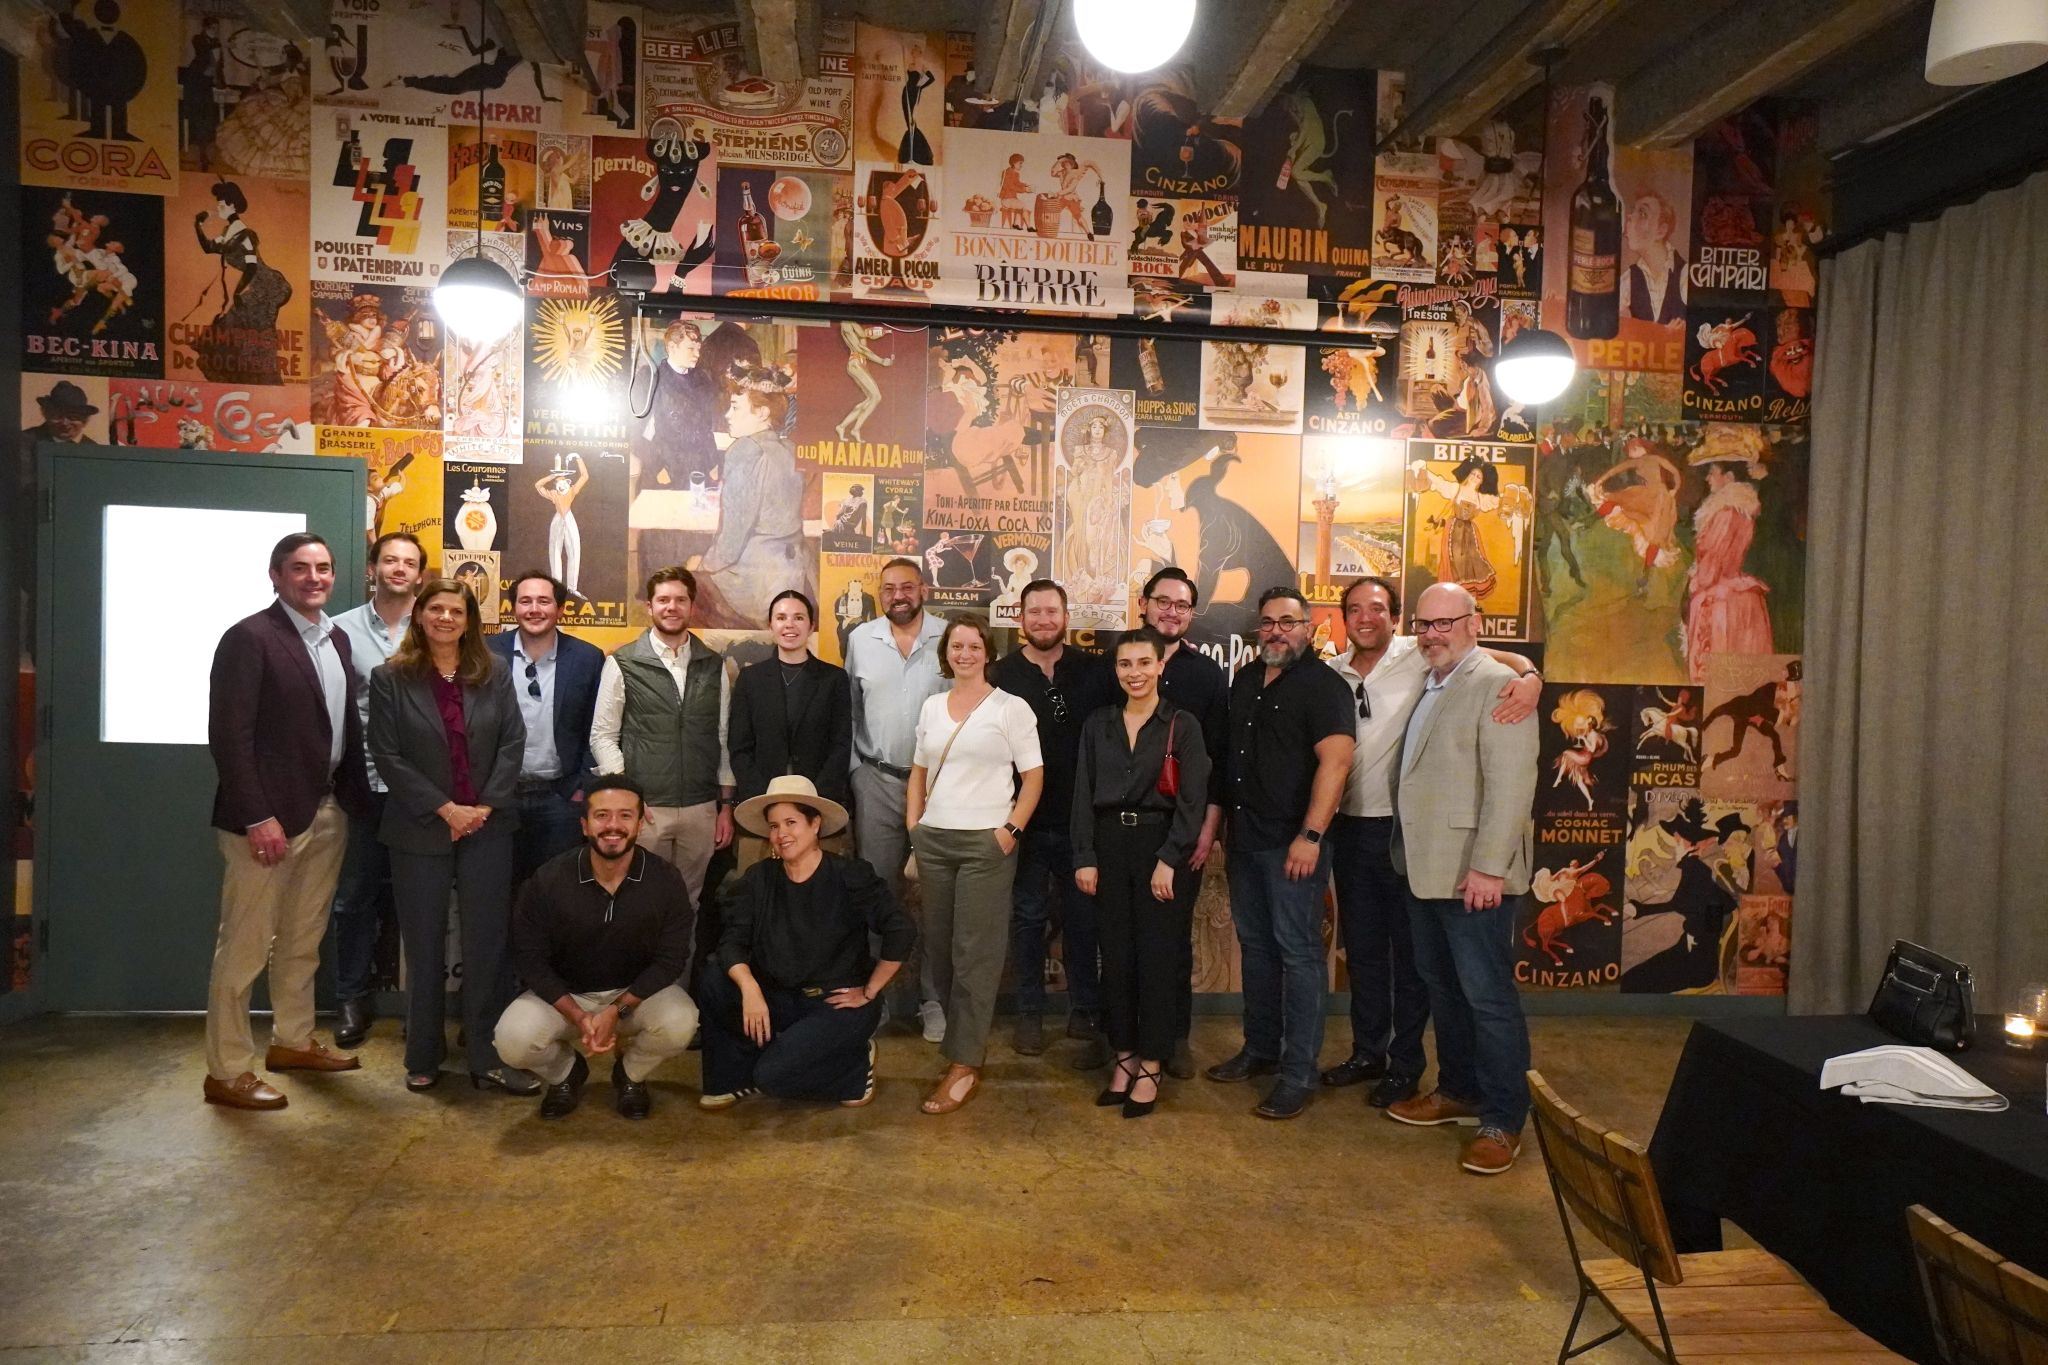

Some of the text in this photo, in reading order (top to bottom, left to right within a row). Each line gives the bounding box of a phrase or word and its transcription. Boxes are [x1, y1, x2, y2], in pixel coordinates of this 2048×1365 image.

[645, 43, 693, 59] BEEF
[808, 87, 843, 97] OLD PORT
[810, 100, 831, 108] WINE
[360, 113, 368, 121] A
[370, 114, 400, 124] VOTRE
[451, 100, 542, 124] CAMPARI
[26, 138, 171, 179] CORA
[1145, 167, 1227, 194] CINZANO
[552, 219, 584, 231] VINS
[314, 240, 374, 256] POUSSET
[1239, 224, 1369, 267] MAURIN QUINA
[1701, 247, 1760, 267] BITTER
[333, 256, 424, 277] SPATENBRÄU
[855, 257, 890, 276] AMER
[1132, 262, 1174, 275] BOCK
[1245, 261, 1285, 272] LE PUY
[1335, 270, 1362, 278] FRANCE
[1689, 263, 1767, 290] CAMPARI
[527, 278, 589, 296] CAMP ROMAIN
[860, 276, 934, 289] CHAUD
[311, 290, 353, 301] CAMPARI
[27, 335, 159, 360] BEC-KINA
[1588, 340, 1683, 369] PERLE
[1683, 390, 1762, 412] CINZANO
[1336, 412, 1360, 421] ASTI
[527, 421, 627, 438] MARTINI
[1308, 415, 1386, 434] CINZANO
[322, 428, 372, 438] GRANDE
[320, 439, 376, 450] BRASSERIE
[524, 438, 558, 446] MARTINI
[797, 441, 924, 468] OLD MANADA RUM
[446, 462, 507, 474] Les Couronnes
[995, 500, 1010, 512] PAR
[992, 532, 1051, 552] VERMOUTH
[448, 553, 496, 565] SCHWEPPES
[1335, 563, 1364, 573] ZARA
[934, 592, 979, 601] BALSAM
[1653, 763, 1685, 772] RHUM
[1632, 772, 1696, 786] INCAS
[1554, 819, 1609, 828] COGNAC
[1541, 828, 1623, 844] MONNET
[1515, 960, 1620, 988] CINZANO
